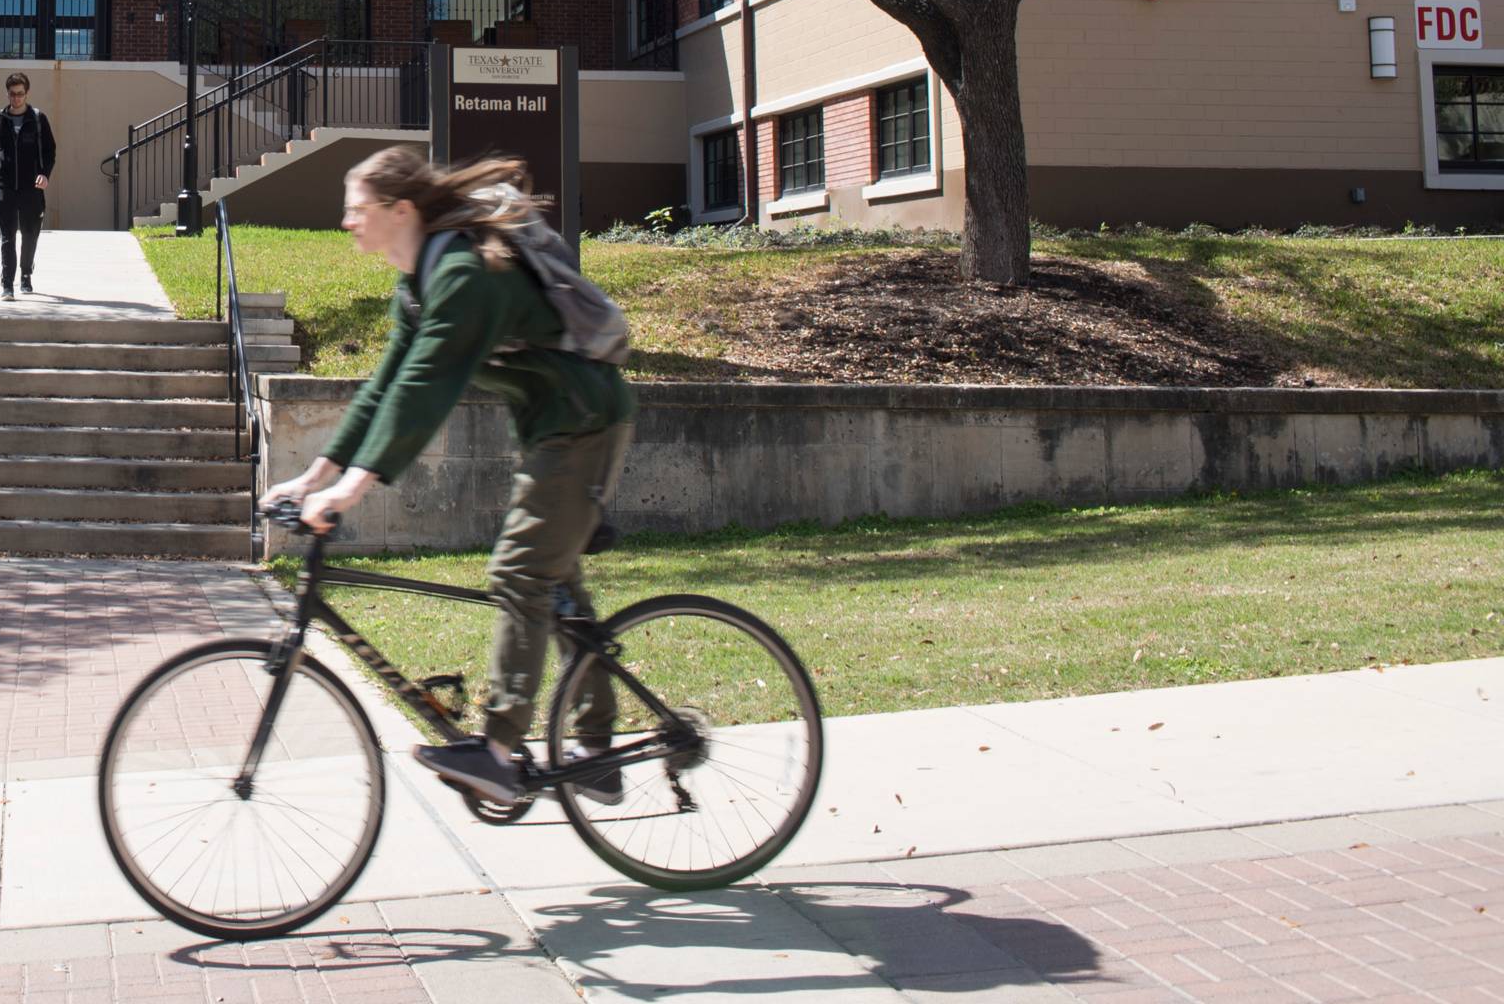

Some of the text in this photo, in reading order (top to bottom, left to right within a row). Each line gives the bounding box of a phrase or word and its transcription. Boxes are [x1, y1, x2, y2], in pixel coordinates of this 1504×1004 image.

[1417, 6, 1480, 42] FDC
[468, 55, 543, 66] TEXAS STATE
[479, 66, 531, 75] UNIVERSITY
[454, 95, 547, 112] Retama Hall
